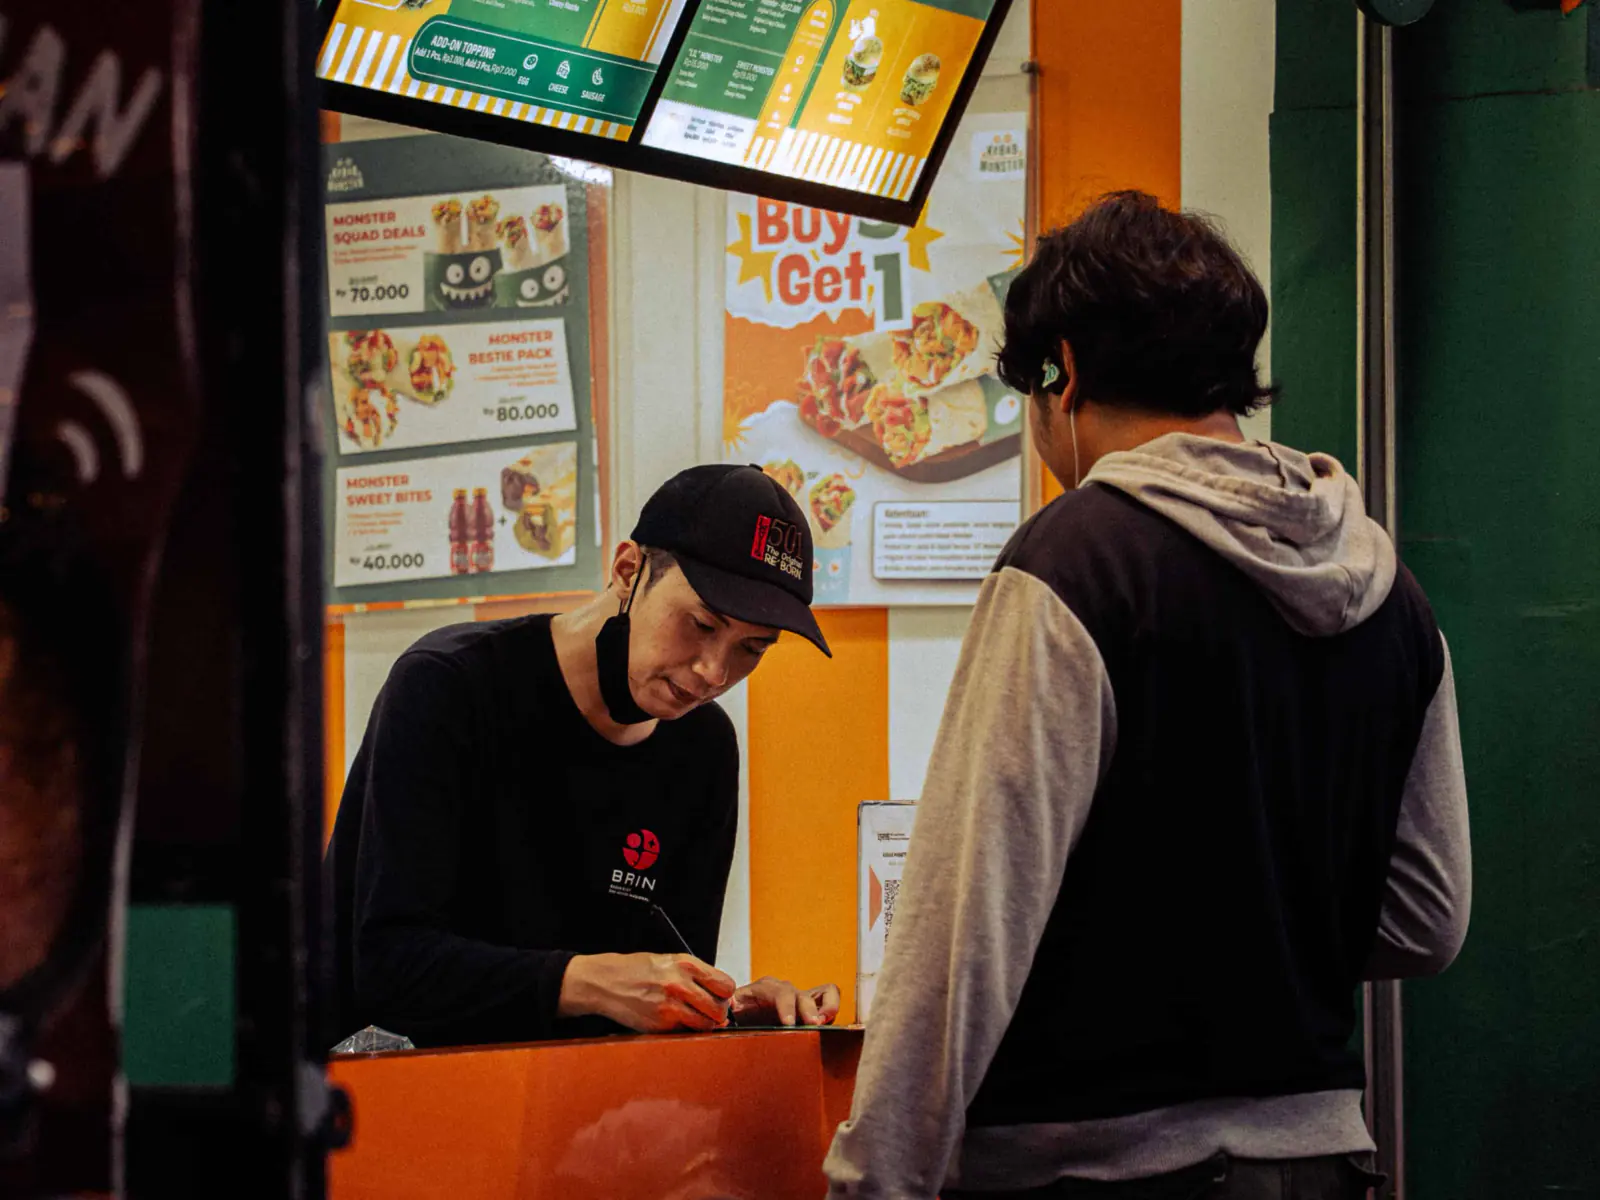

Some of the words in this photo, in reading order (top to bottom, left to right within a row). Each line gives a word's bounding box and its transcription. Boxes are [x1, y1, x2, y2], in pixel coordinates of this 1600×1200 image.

[430, 35, 463, 52] ADD-ON
[462, 41, 497, 60] TOPPING
[415, 47, 426, 58] Add
[465, 58, 477, 69] Add
[548, 82, 569, 94] CHEESE
[333, 210, 397, 226] MONSTER
[757, 196, 852, 255] Buy
[333, 230, 380, 245] SQUAD
[382, 225, 425, 240] DEALS
[350, 284, 409, 302] 70.000
[778, 251, 867, 306] Get
[874, 252, 904, 321] 1
[488, 330, 553, 345] MONSTER
[468, 350, 514, 365] BESTIE
[517, 348, 553, 361] PACK
[496, 403, 559, 422] 80.000
[346, 474, 409, 490] MONSTER
[346, 492, 392, 507] SWEET
[395, 489, 432, 504] BITES
[766, 544, 780, 557] The
[363, 553, 425, 570] 40.000
[611, 869, 656, 891] BRIN
